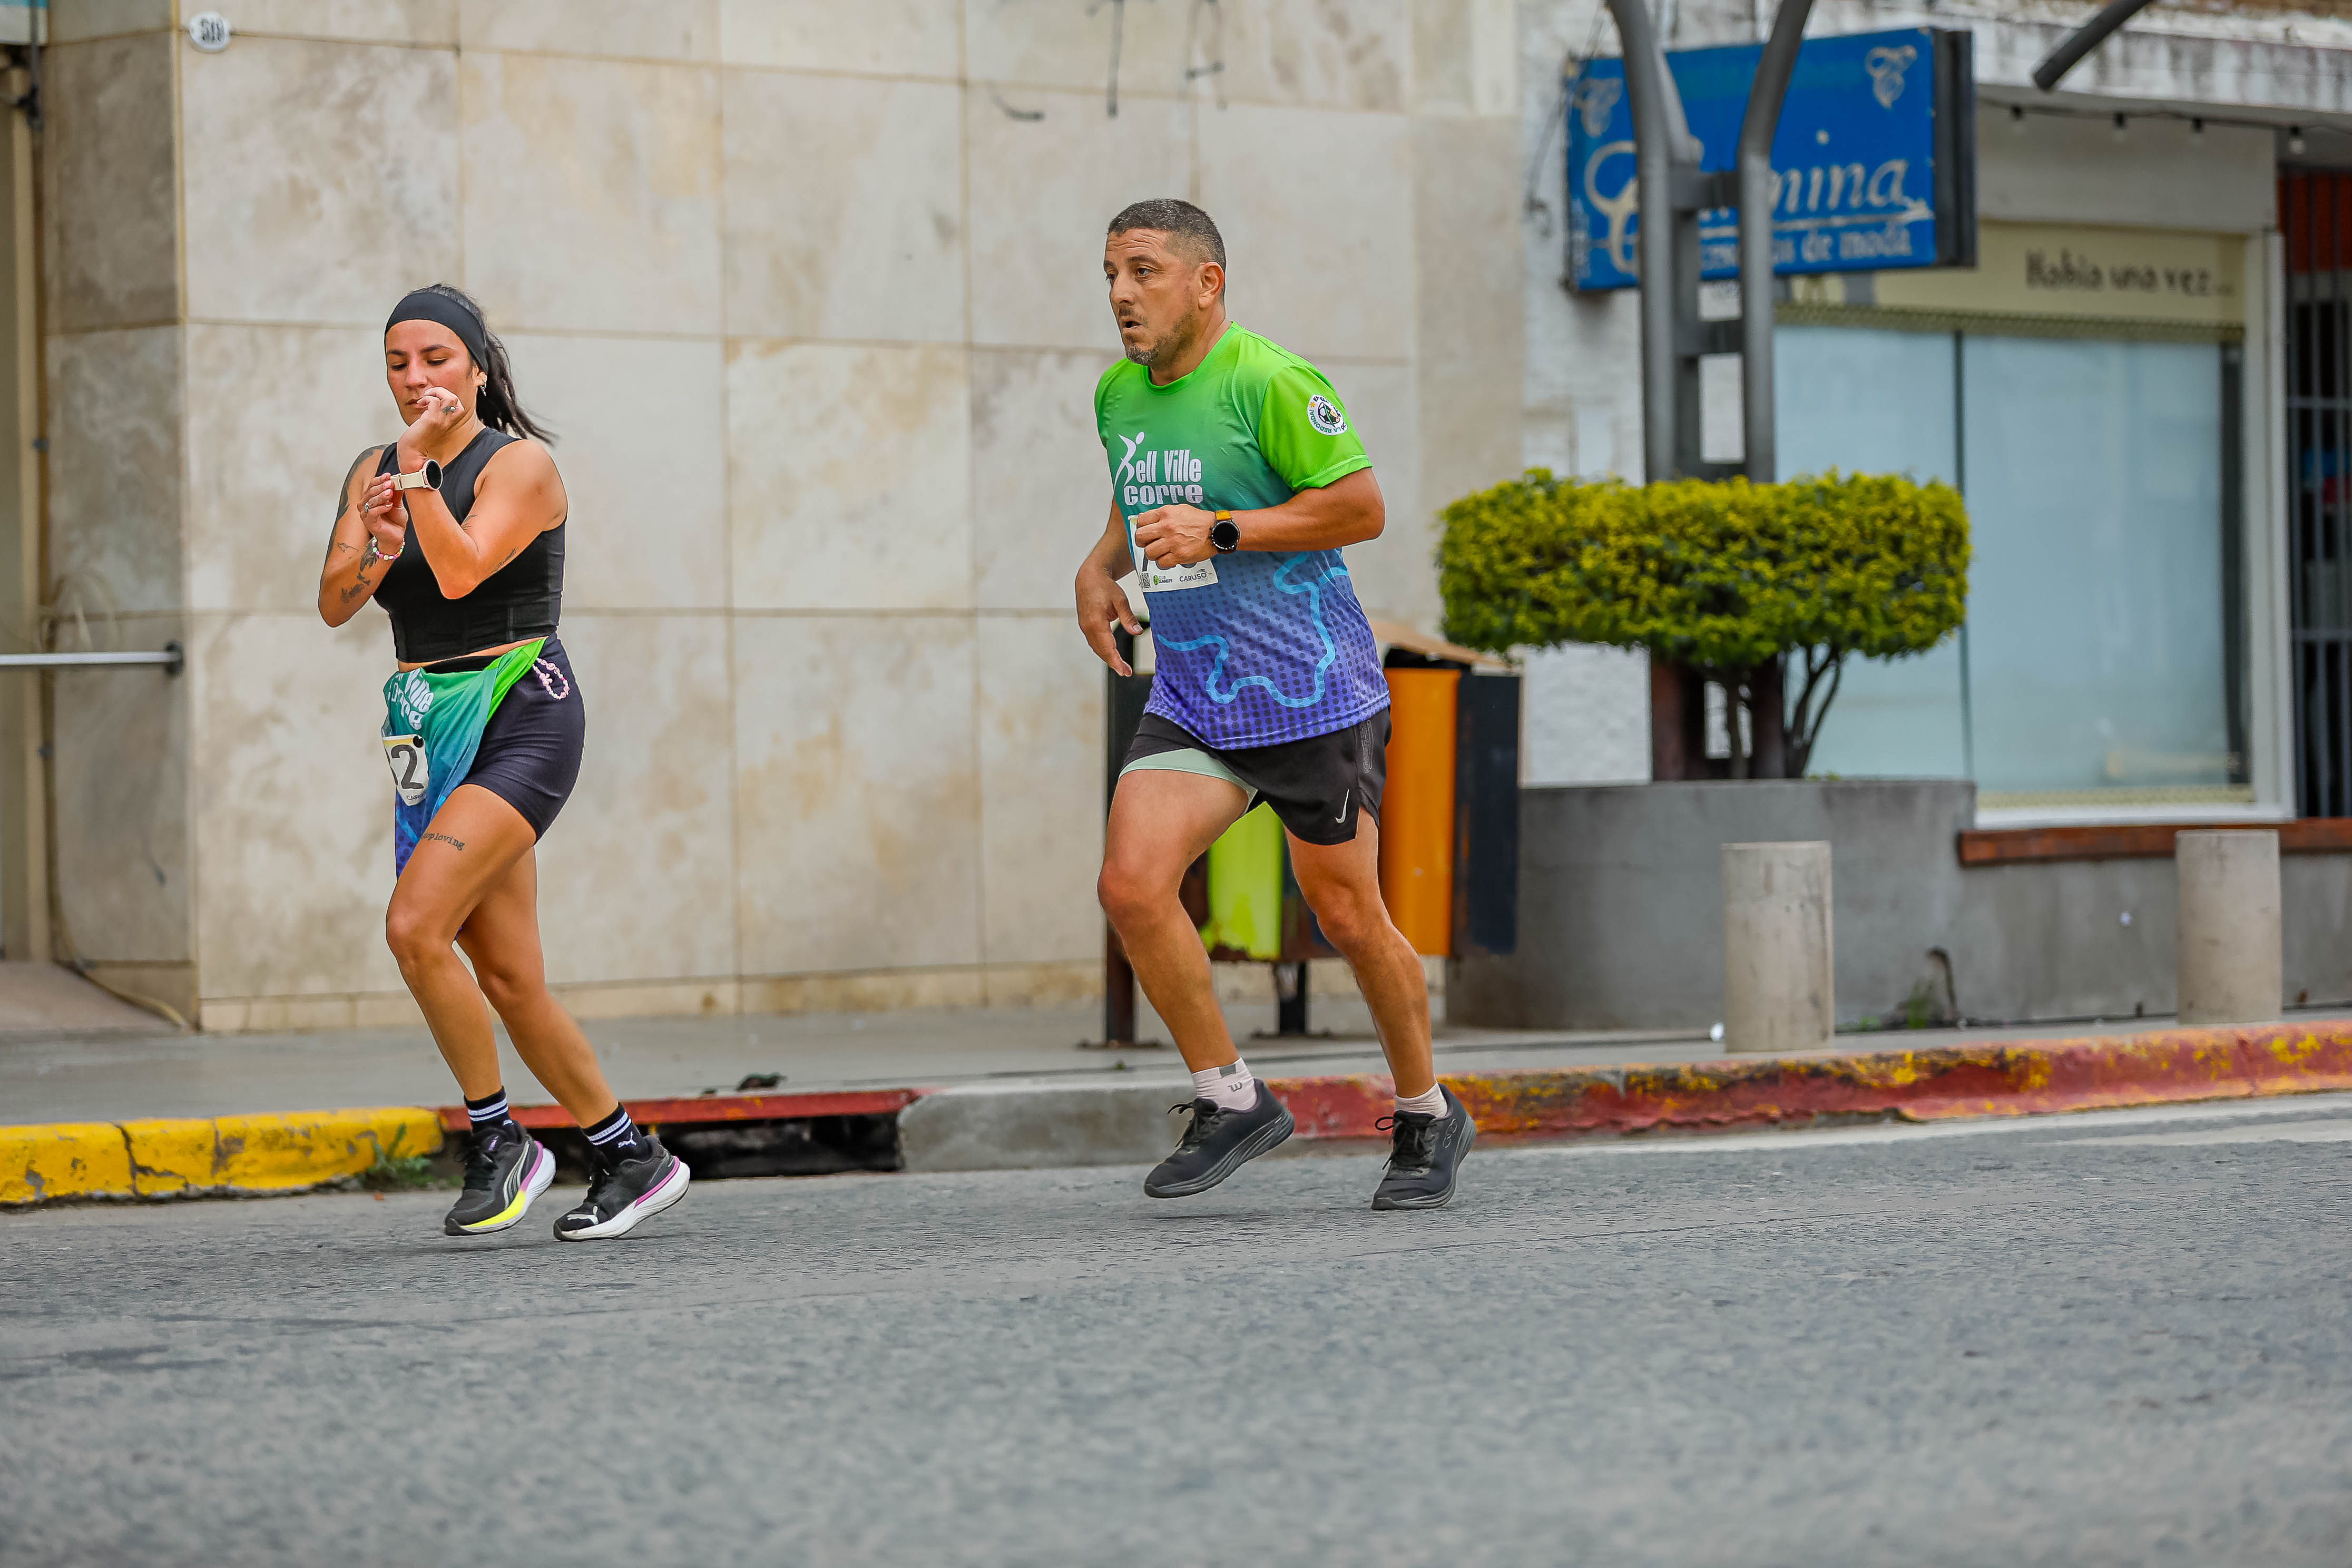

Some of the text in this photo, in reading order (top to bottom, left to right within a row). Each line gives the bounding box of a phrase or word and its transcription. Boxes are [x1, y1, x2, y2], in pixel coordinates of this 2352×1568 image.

[1163, 449, 1202, 483] Ville
[1123, 484, 1203, 505] corre
[1179, 572, 1207, 582] CARUSO
[434, 833, 465, 851] loving
